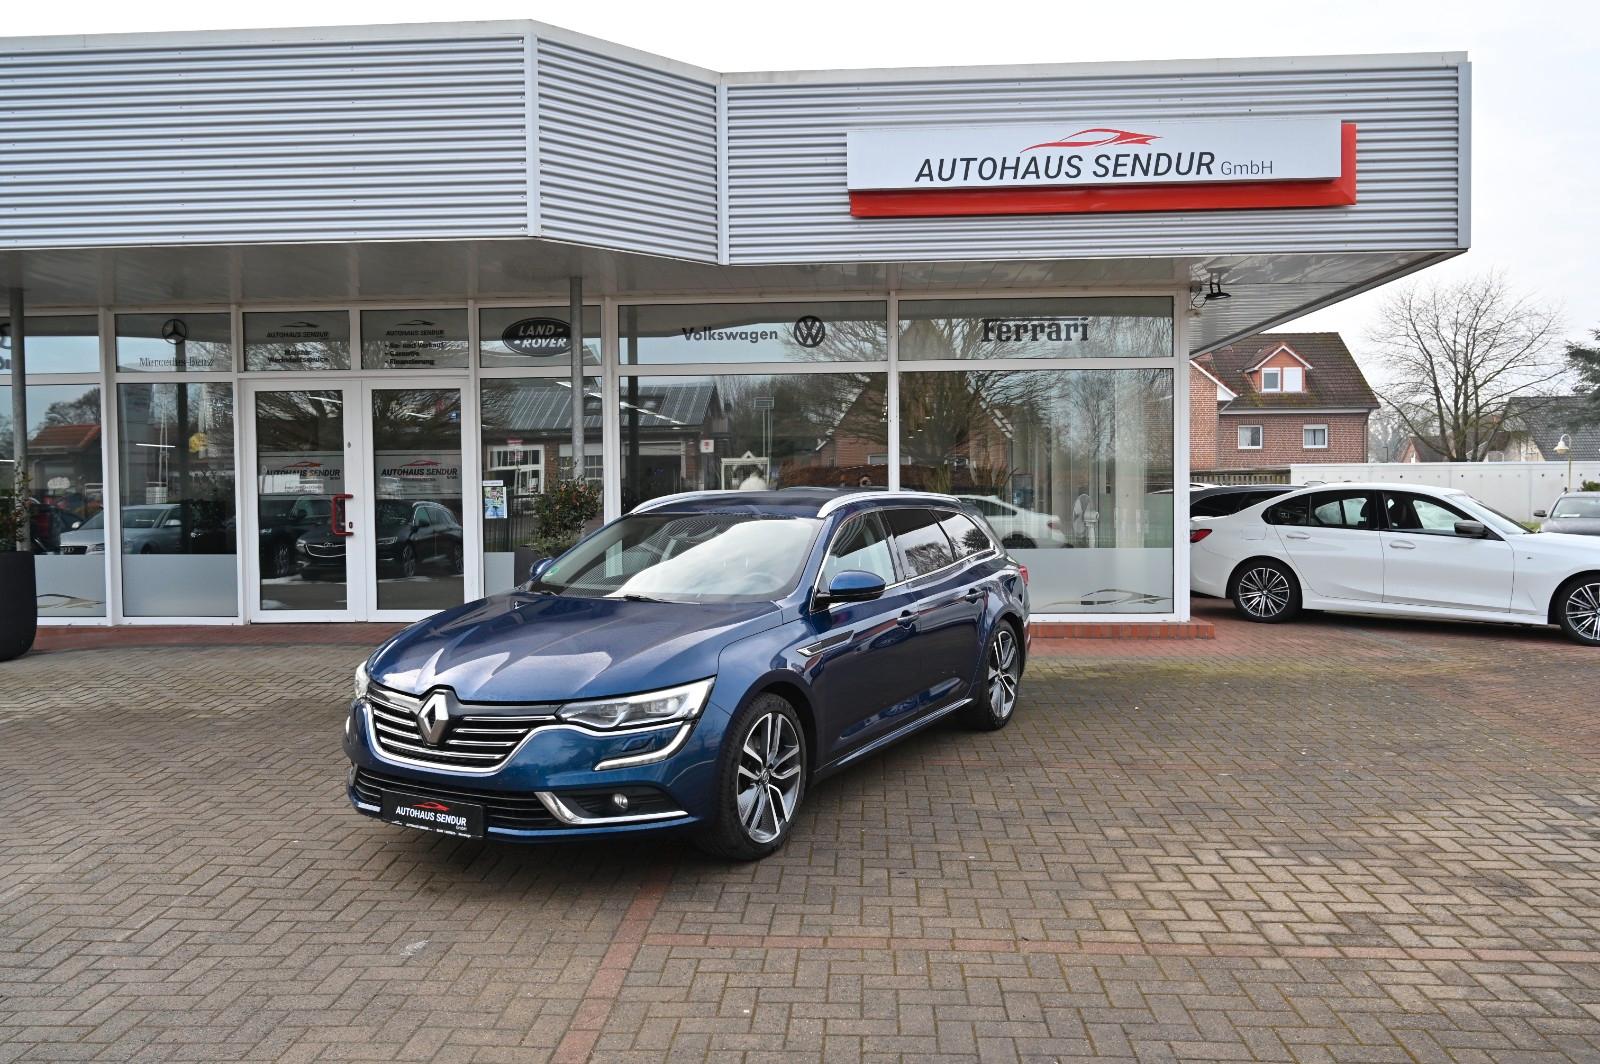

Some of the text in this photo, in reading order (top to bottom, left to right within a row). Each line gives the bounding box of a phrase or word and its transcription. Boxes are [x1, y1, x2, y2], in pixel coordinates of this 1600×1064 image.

[914, 151, 1273, 182] AUTOHAUS SENDUR GmbH
[682, 327, 778, 344] Volkswagen
[981, 317, 1089, 342] Ferrari
[139, 356, 215, 367] Mercedes-Benz
[309, 469, 341, 477] SENDUR
[381, 467, 458, 476] AUTOHAUS SENDUR
[395, 805, 467, 826] AUTOHAUS SENDUR
